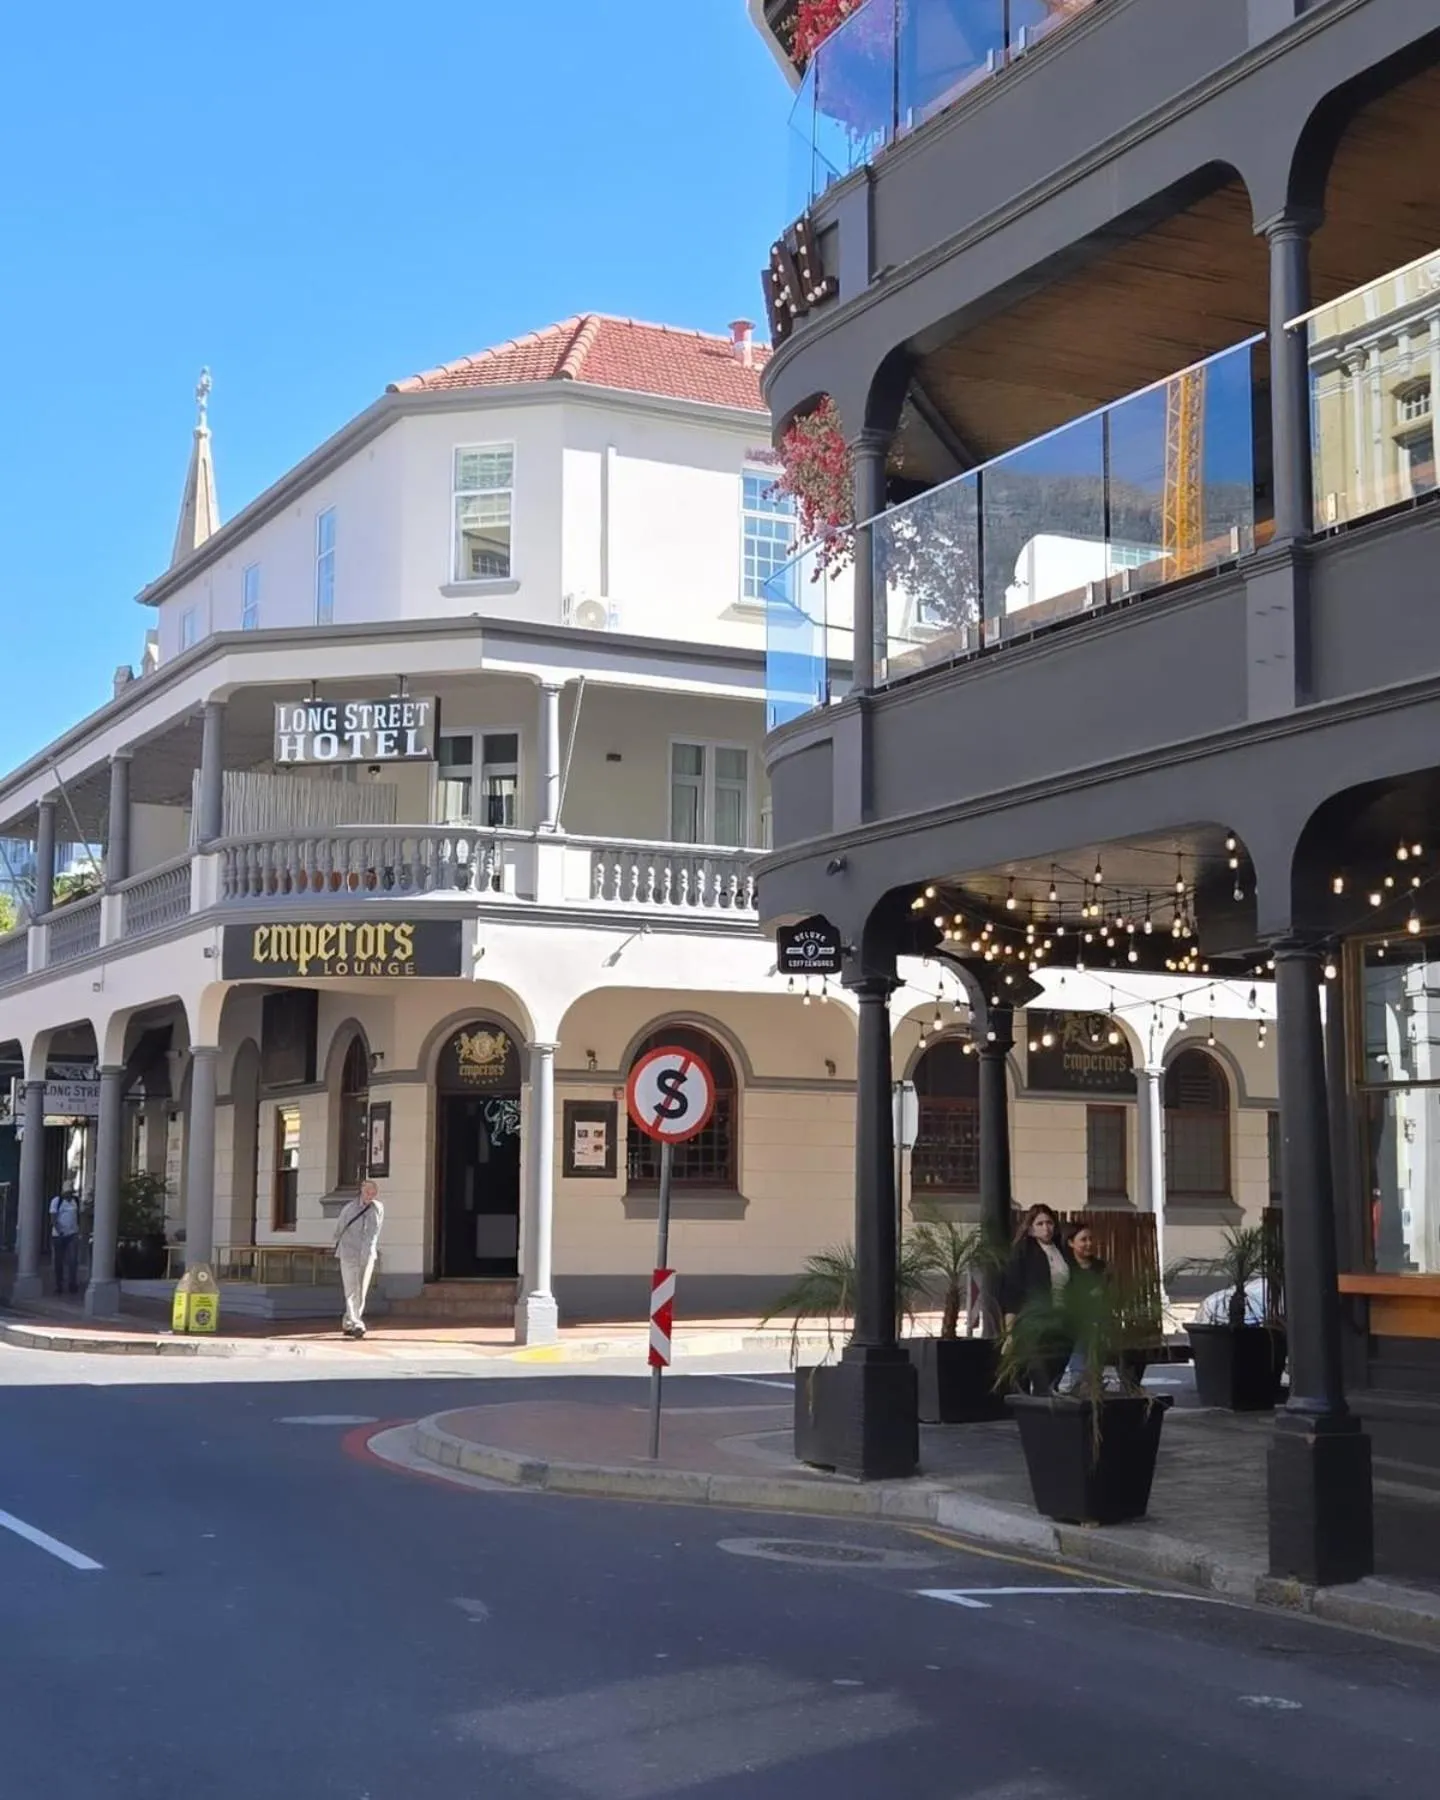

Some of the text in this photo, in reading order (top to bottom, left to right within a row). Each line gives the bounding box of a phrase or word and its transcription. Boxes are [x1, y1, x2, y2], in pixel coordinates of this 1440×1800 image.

[279, 702, 429, 733] LONG STREET
[278, 730, 427, 762] HOTEL
[253, 922, 415, 975] emperors
[793, 931, 826, 943] DELUXE
[324, 961, 416, 975] LOUNGE
[44, 1084, 71, 1096] LONG
[653, 1069, 688, 1119] S
